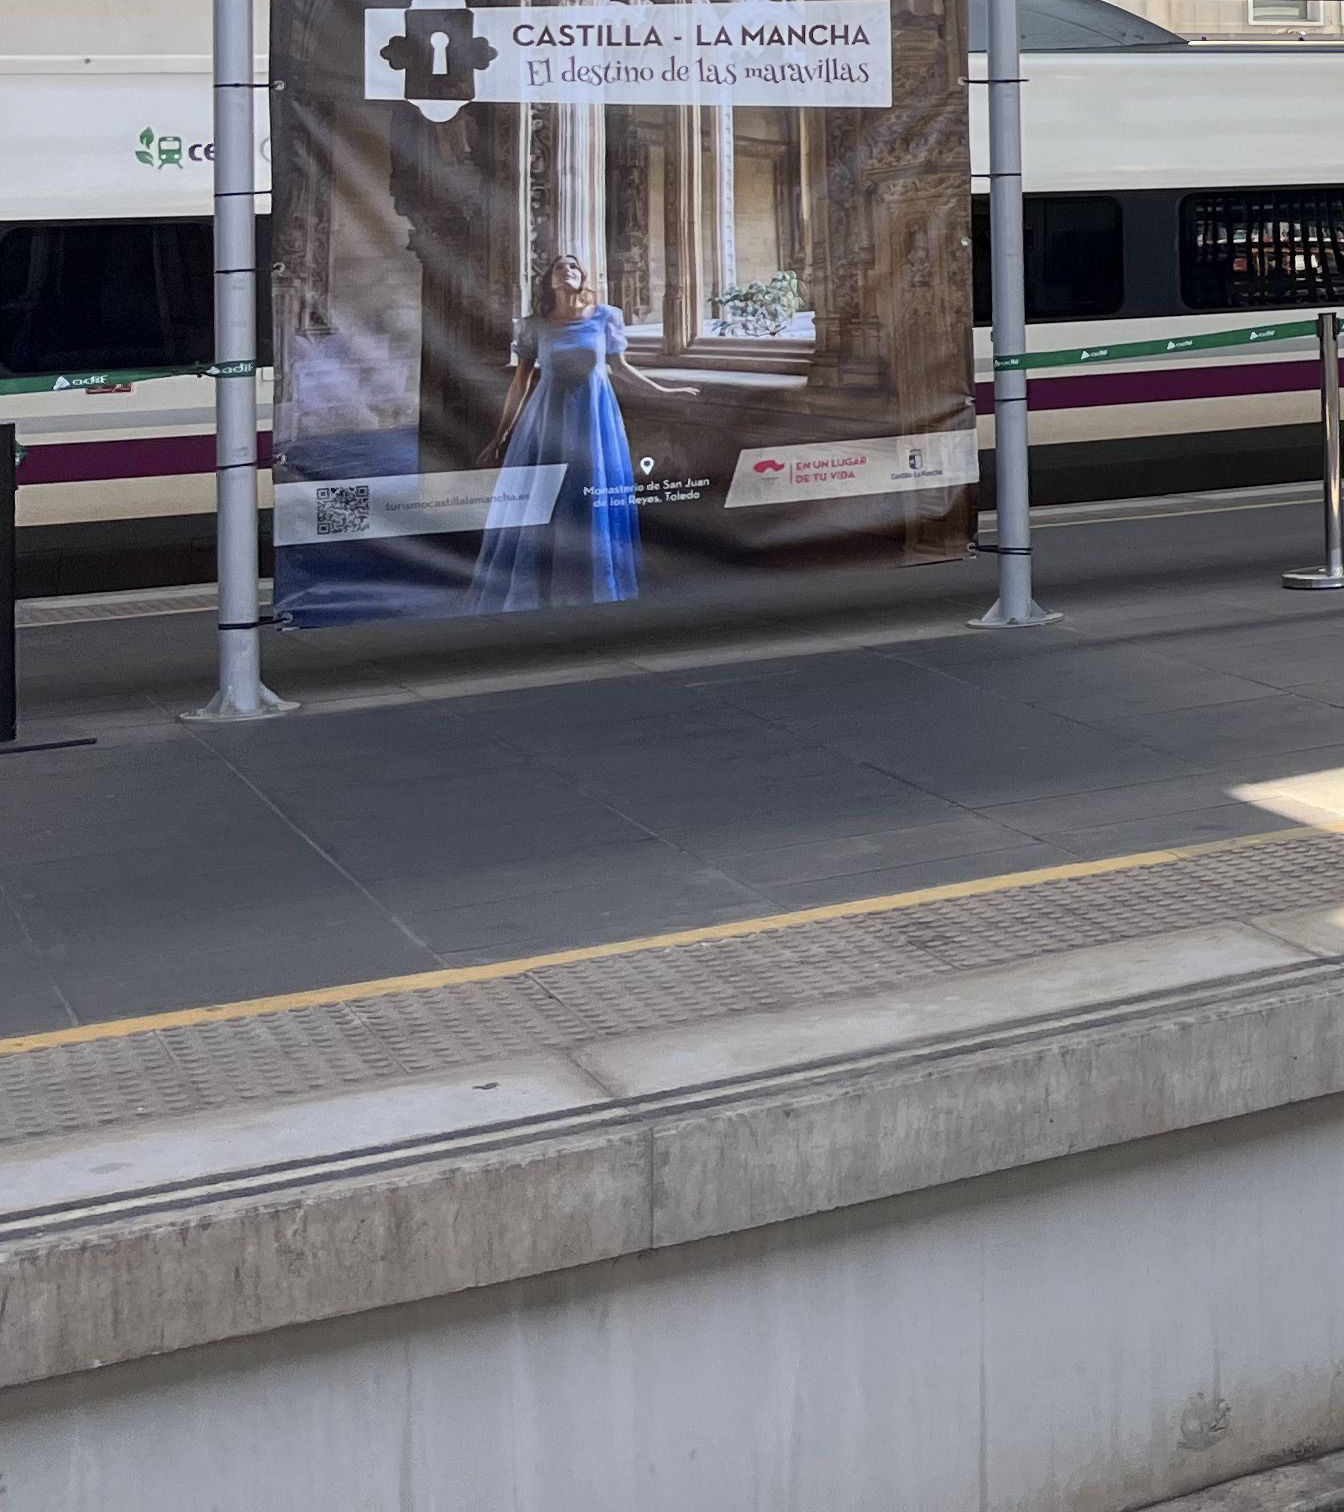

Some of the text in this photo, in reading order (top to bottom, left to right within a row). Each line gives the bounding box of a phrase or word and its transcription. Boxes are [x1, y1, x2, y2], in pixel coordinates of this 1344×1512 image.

[512, 24, 664, 46] CASTILLA
[696, 25, 733, 46] LA
[741, 25, 871, 46] MANCHA
[527, 56, 871, 86] El destino de las maravillas
[222, 362, 253, 374] adif
[72, 374, 109, 385] adif
[796, 456, 867, 471] EN UN LUGAR
[795, 470, 855, 483] DE TU VIDA
[583, 478, 710, 496] Monasterio de San Juan
[593, 497, 608, 508] de
[610, 496, 625, 506] los
[665, 490, 700, 502] Toledo
